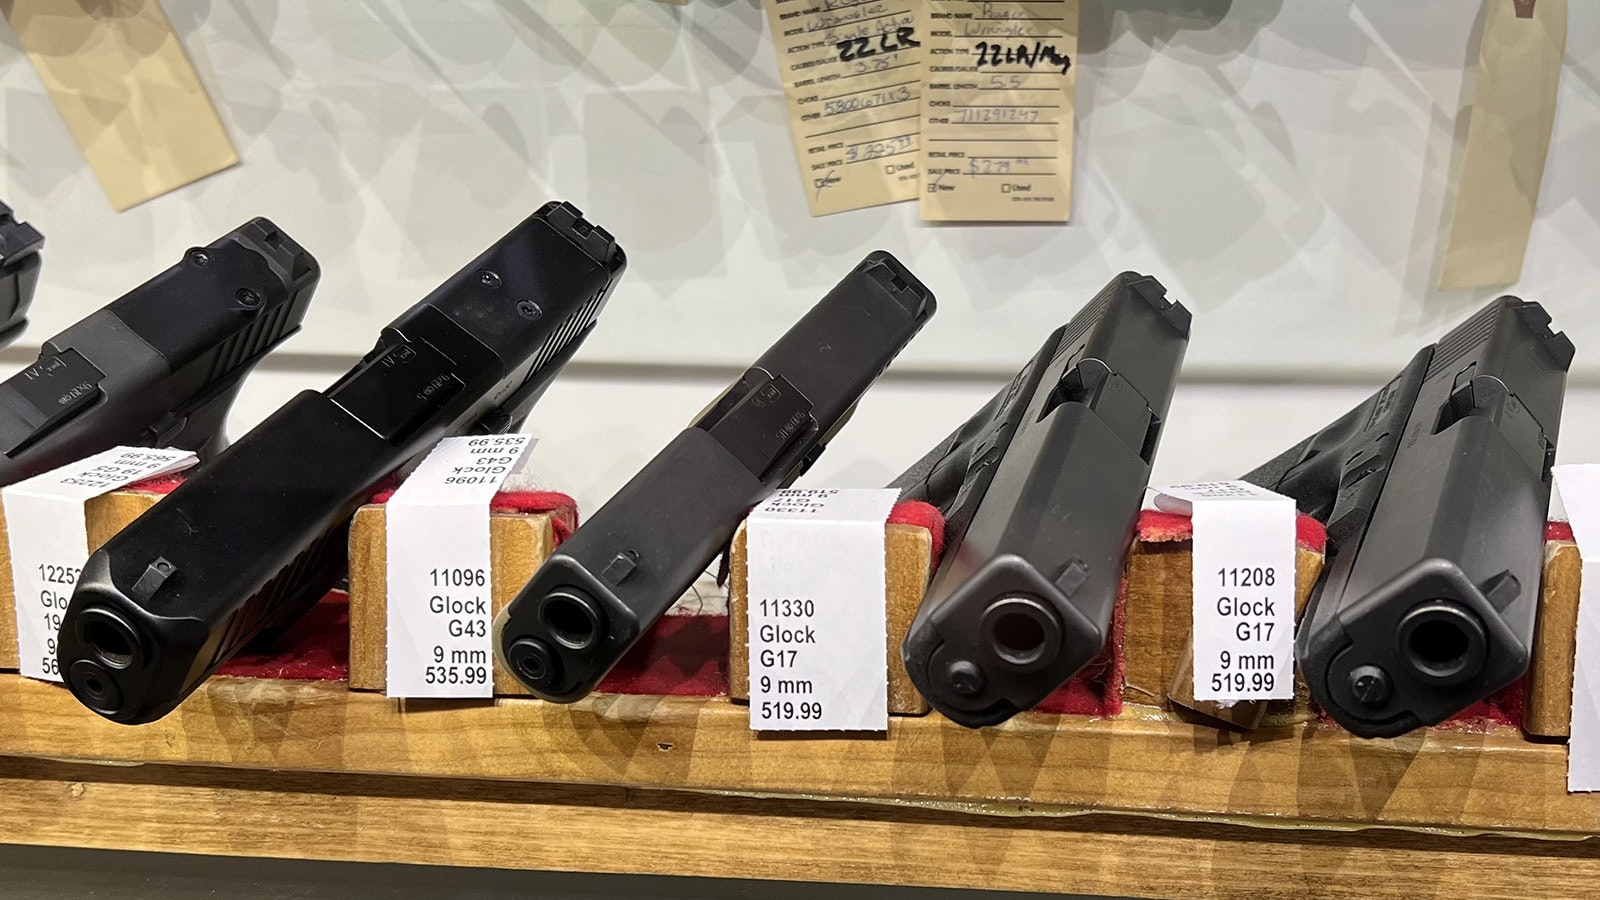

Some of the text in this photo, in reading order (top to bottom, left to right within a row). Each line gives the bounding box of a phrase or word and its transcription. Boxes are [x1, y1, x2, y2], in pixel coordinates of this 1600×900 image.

[837, 27, 921, 62] 22 LR
[468, 437, 526, 446] 535.99
[508, 447, 519, 455] 9
[452, 466, 506, 474] Glock
[476, 457, 513, 465] G43
[445, 476, 498, 485] 11096
[430, 568, 486, 587] 11096
[1218, 567, 1275, 587] 11208
[40, 590, 68, 610] Glo
[429, 595, 486, 614] Glock
[760, 599, 815, 617] 11330
[1217, 596, 1275, 616] Glock
[44, 613, 61, 631] 19
[448, 618, 487, 638] G43
[1236, 622, 1275, 641] G17
[760, 624, 816, 644] Glock
[47, 638, 56, 655] 9
[433, 645, 487, 664] 9 mm
[760, 649, 798, 668] G17
[1220, 650, 1275, 670] 9 mm
[425, 666, 487, 684] 535.99
[760, 675, 813, 694] 9 mm
[1211, 672, 1275, 692] 519.99
[761, 701, 823, 720] 519.99
